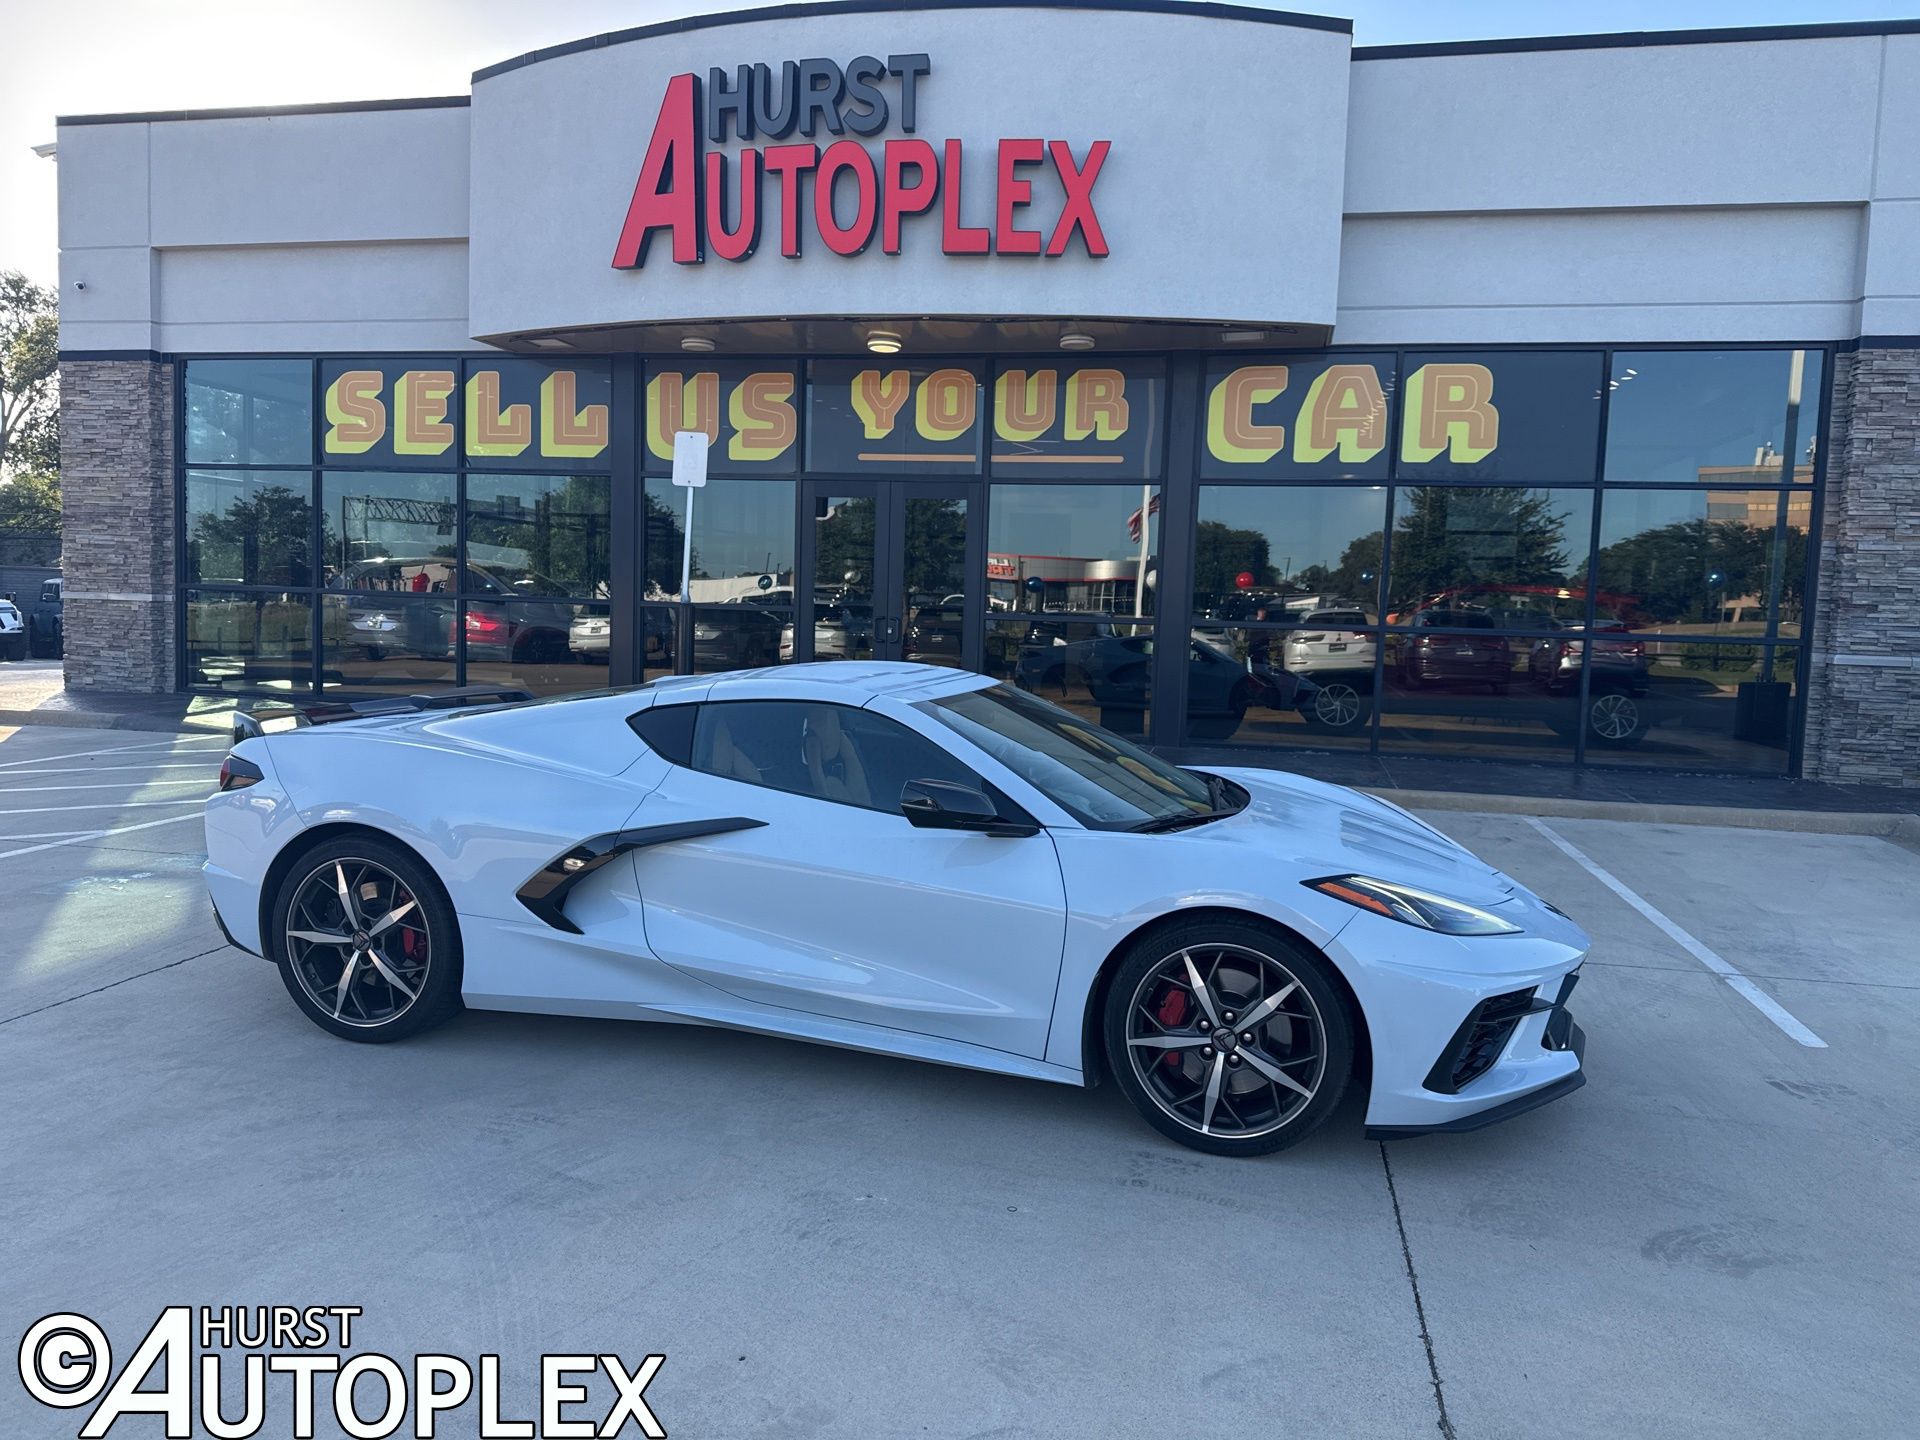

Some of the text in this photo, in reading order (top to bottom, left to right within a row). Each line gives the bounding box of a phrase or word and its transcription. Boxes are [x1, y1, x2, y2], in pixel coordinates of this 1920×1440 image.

[708, 53, 931, 143] HURST
[611, 72, 1112, 269] AUTOPLEX
[325, 363, 1500, 464] SELL US YOUR CAR
